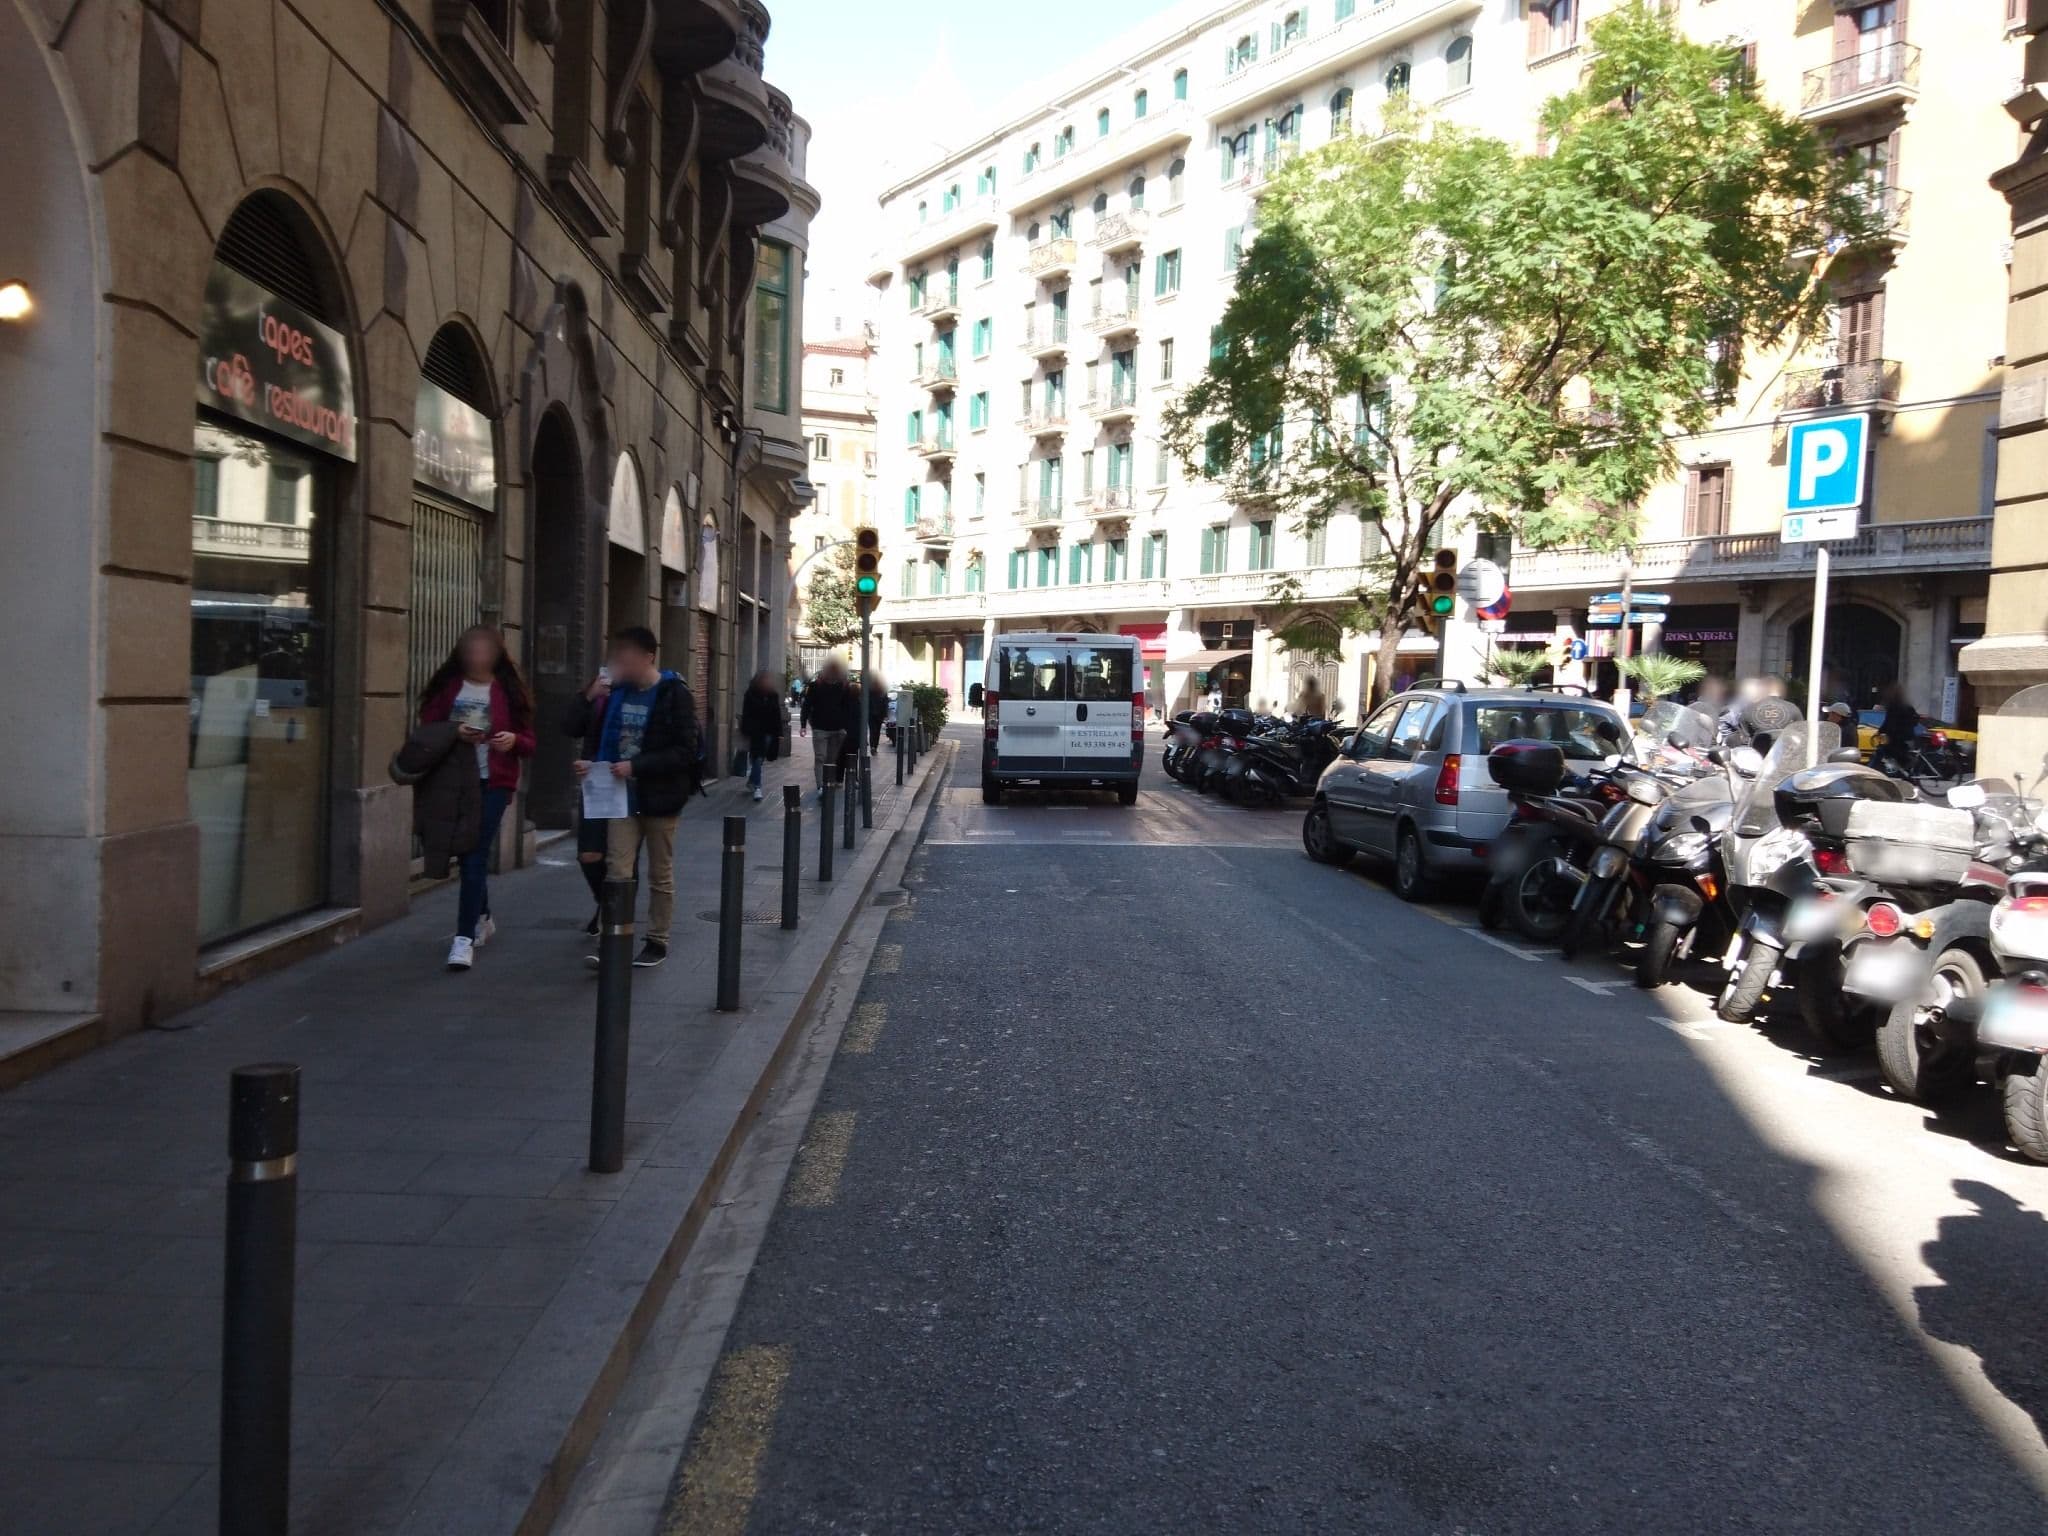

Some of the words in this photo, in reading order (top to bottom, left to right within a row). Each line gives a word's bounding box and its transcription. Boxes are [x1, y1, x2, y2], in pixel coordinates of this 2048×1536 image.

[259, 302, 314, 367] tapes
[1799, 428, 1848, 501] P
[1664, 632, 1693, 641] ROSA
[1696, 631, 1734, 641] NEGRA
